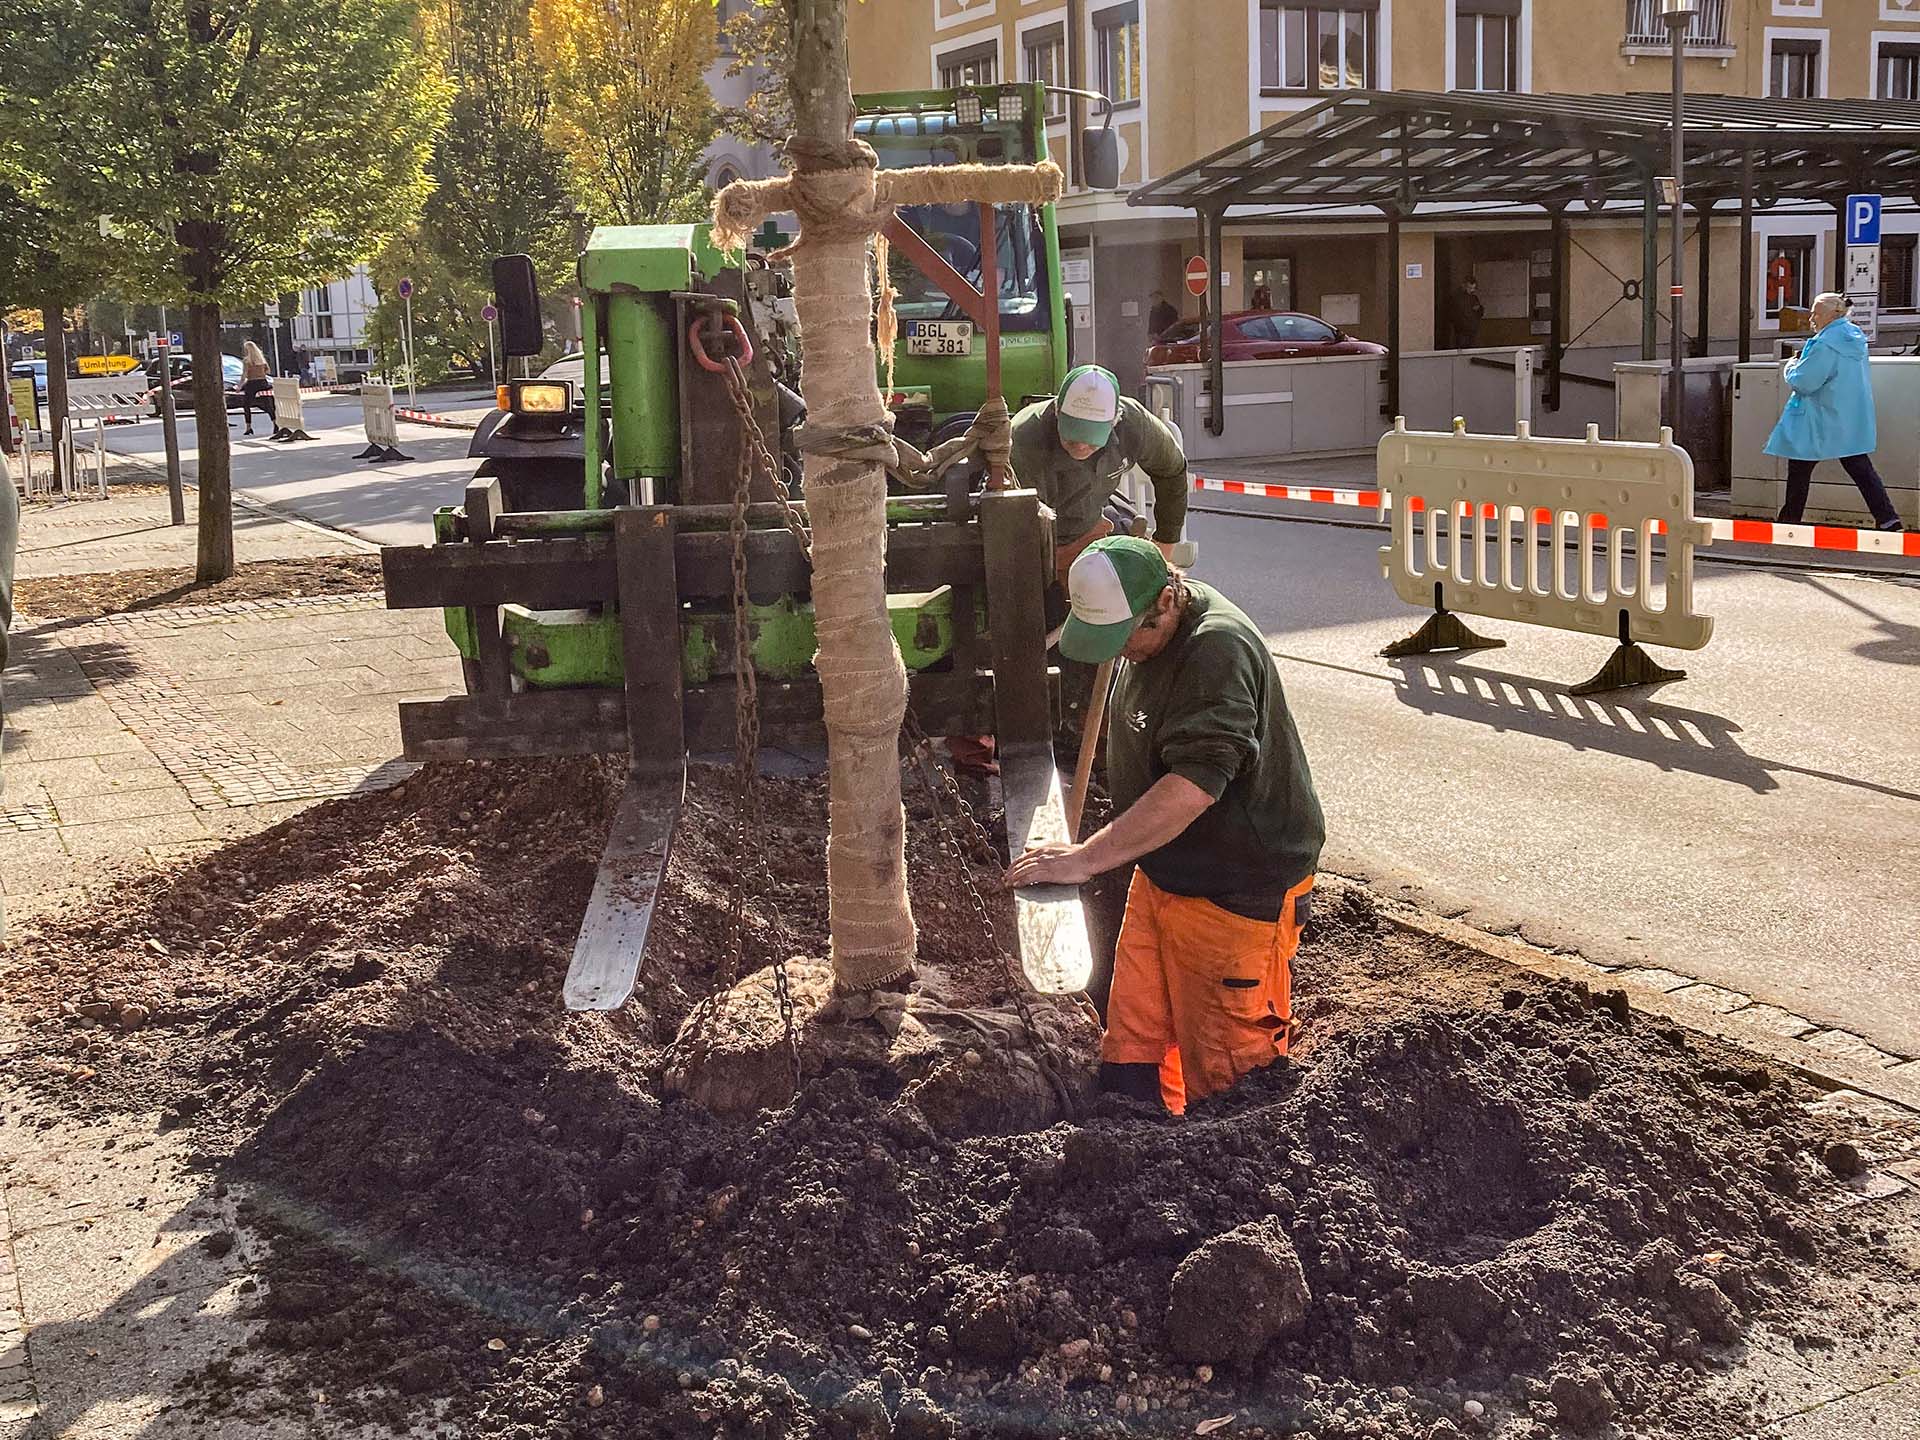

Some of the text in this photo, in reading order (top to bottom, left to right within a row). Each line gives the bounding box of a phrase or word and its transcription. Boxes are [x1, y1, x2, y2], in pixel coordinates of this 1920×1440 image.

[1853, 201, 1874, 239] P
[917, 323, 947, 338] BGL
[171, 334, 180, 345] P
[936, 339, 965, 354] 381
[83, 360, 127, 369] Umletung
